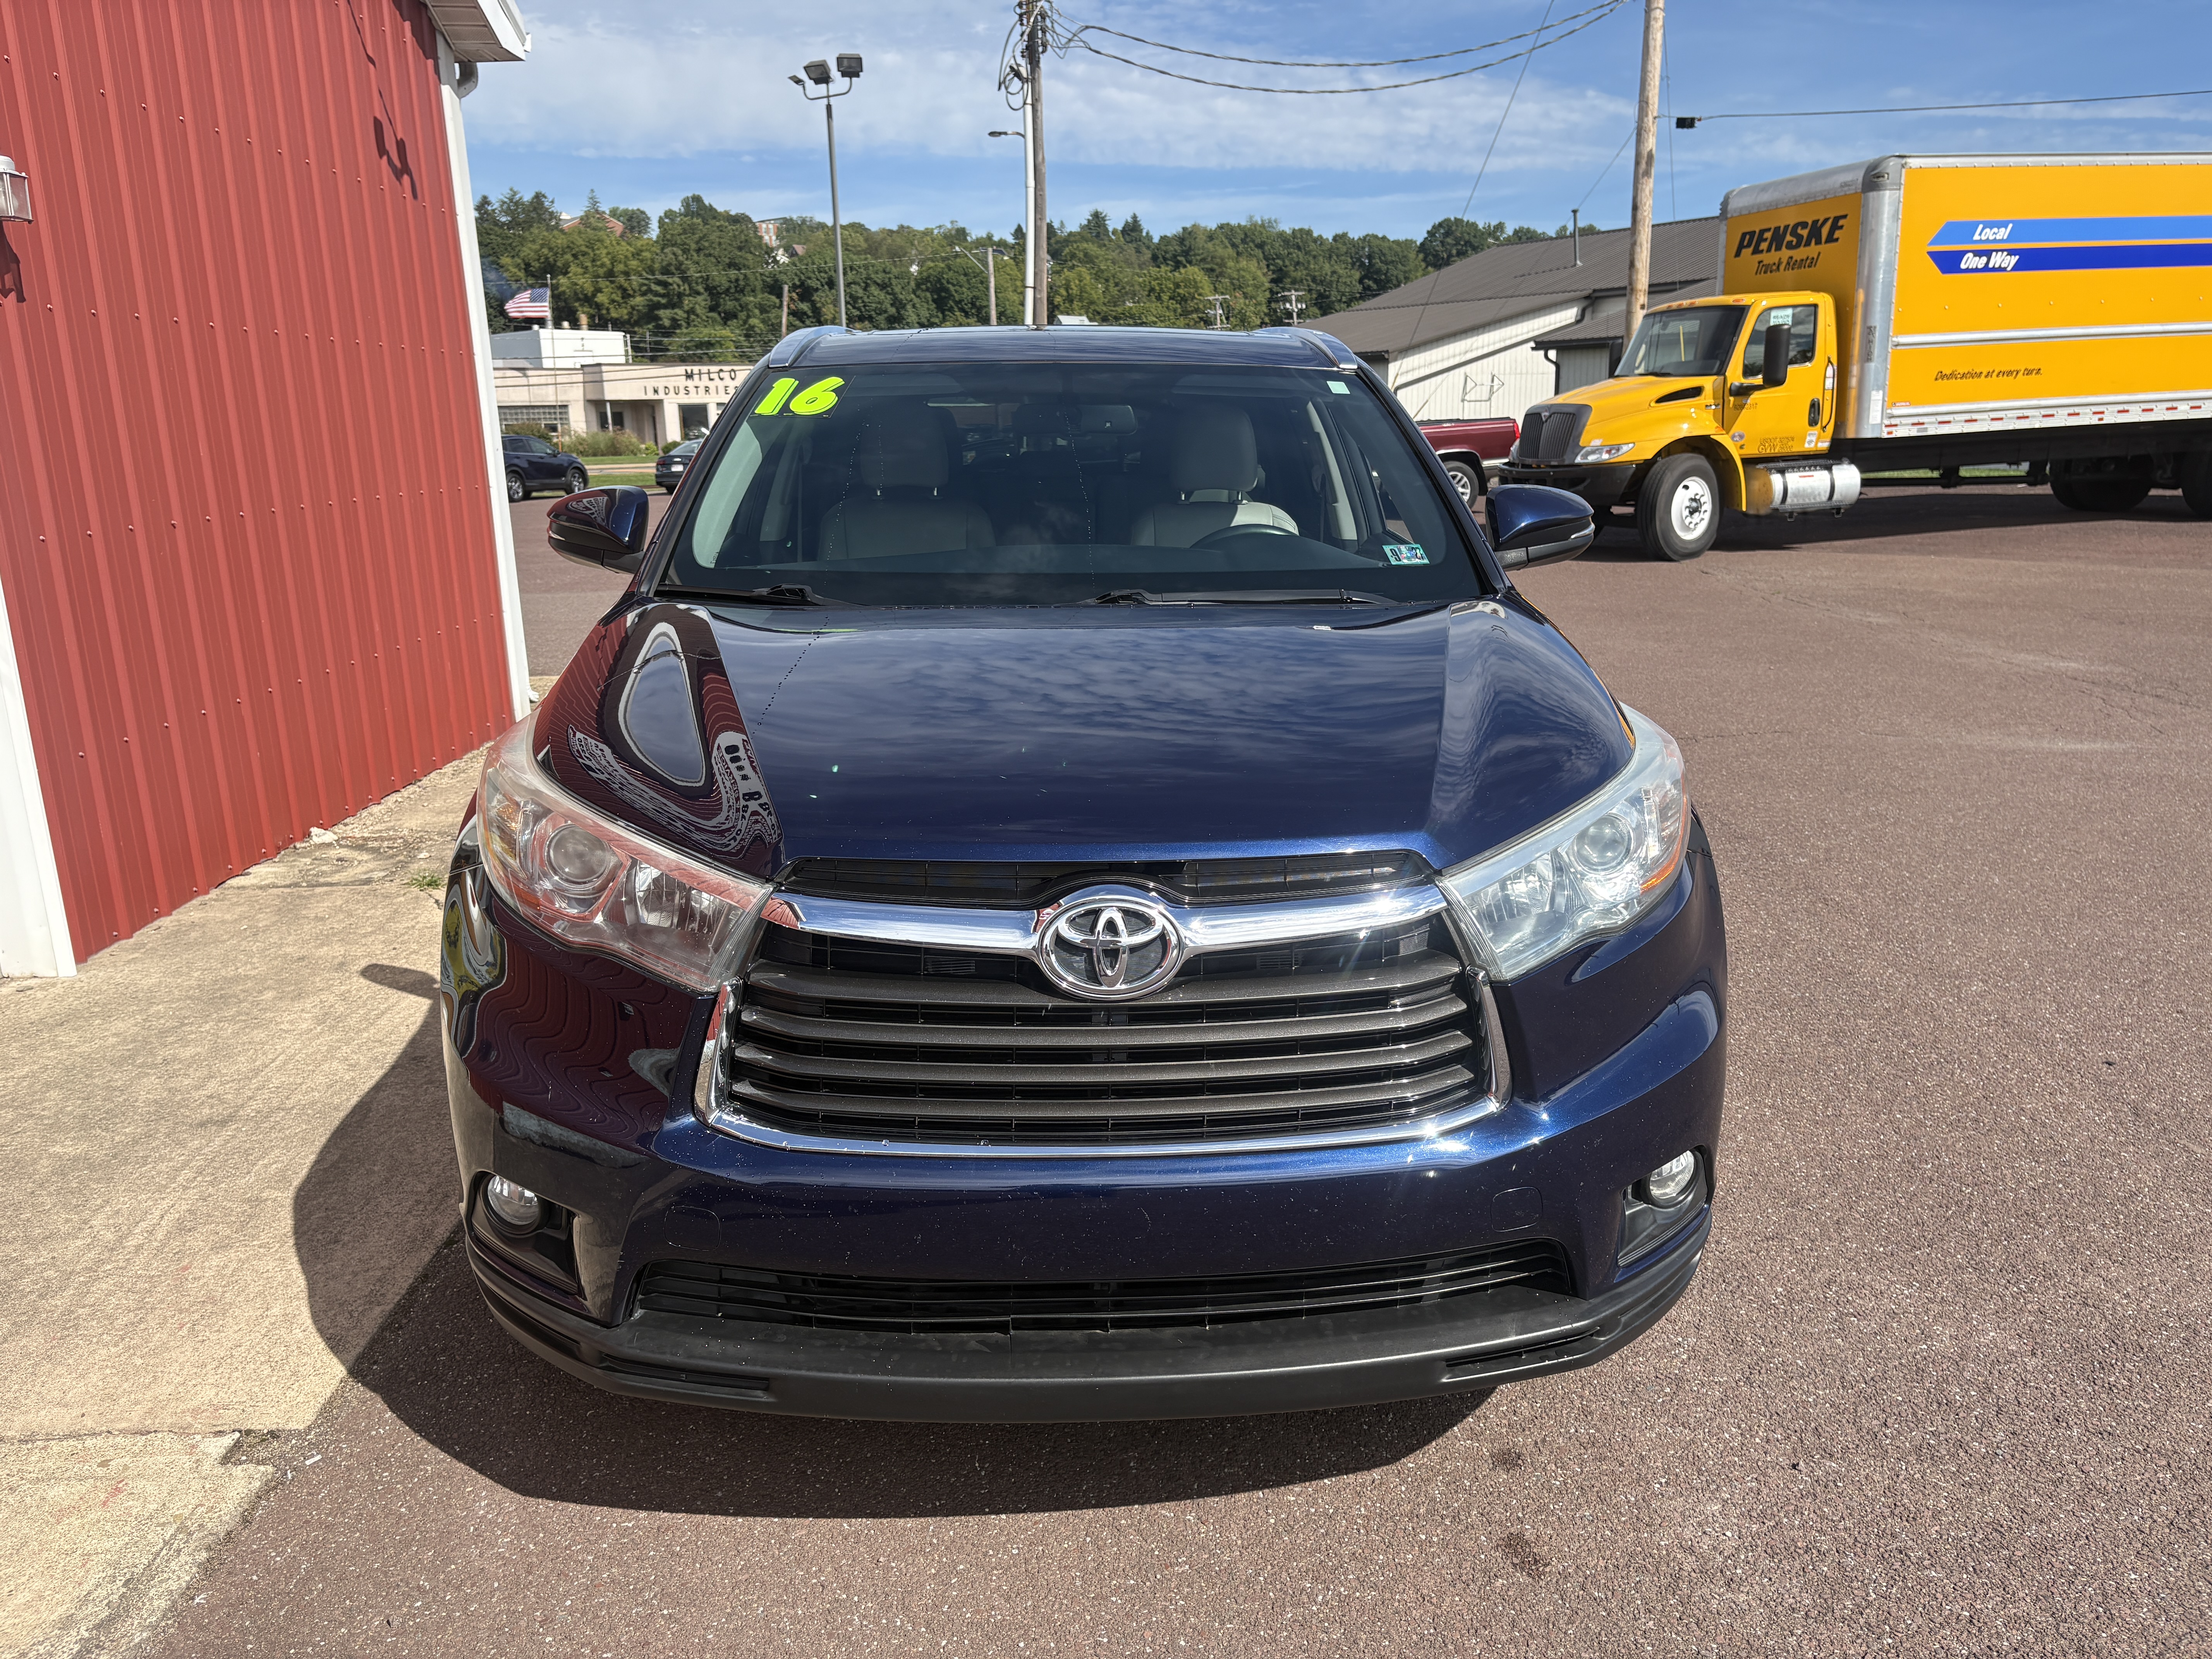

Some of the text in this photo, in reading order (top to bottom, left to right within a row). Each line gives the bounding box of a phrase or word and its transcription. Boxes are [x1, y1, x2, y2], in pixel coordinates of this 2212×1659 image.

[1734, 214, 1848, 258] PENSKE
[1973, 223, 2013, 240] Local
[1755, 251, 1821, 276] Truck Rental
[1960, 251, 2020, 271] One Way
[685, 368, 737, 381] MILCO
[1934, 368, 1983, 381] Dedication
[1984, 369, 1996, 379] at
[1996, 368, 2021, 380] every
[754, 376, 845, 416] 16
